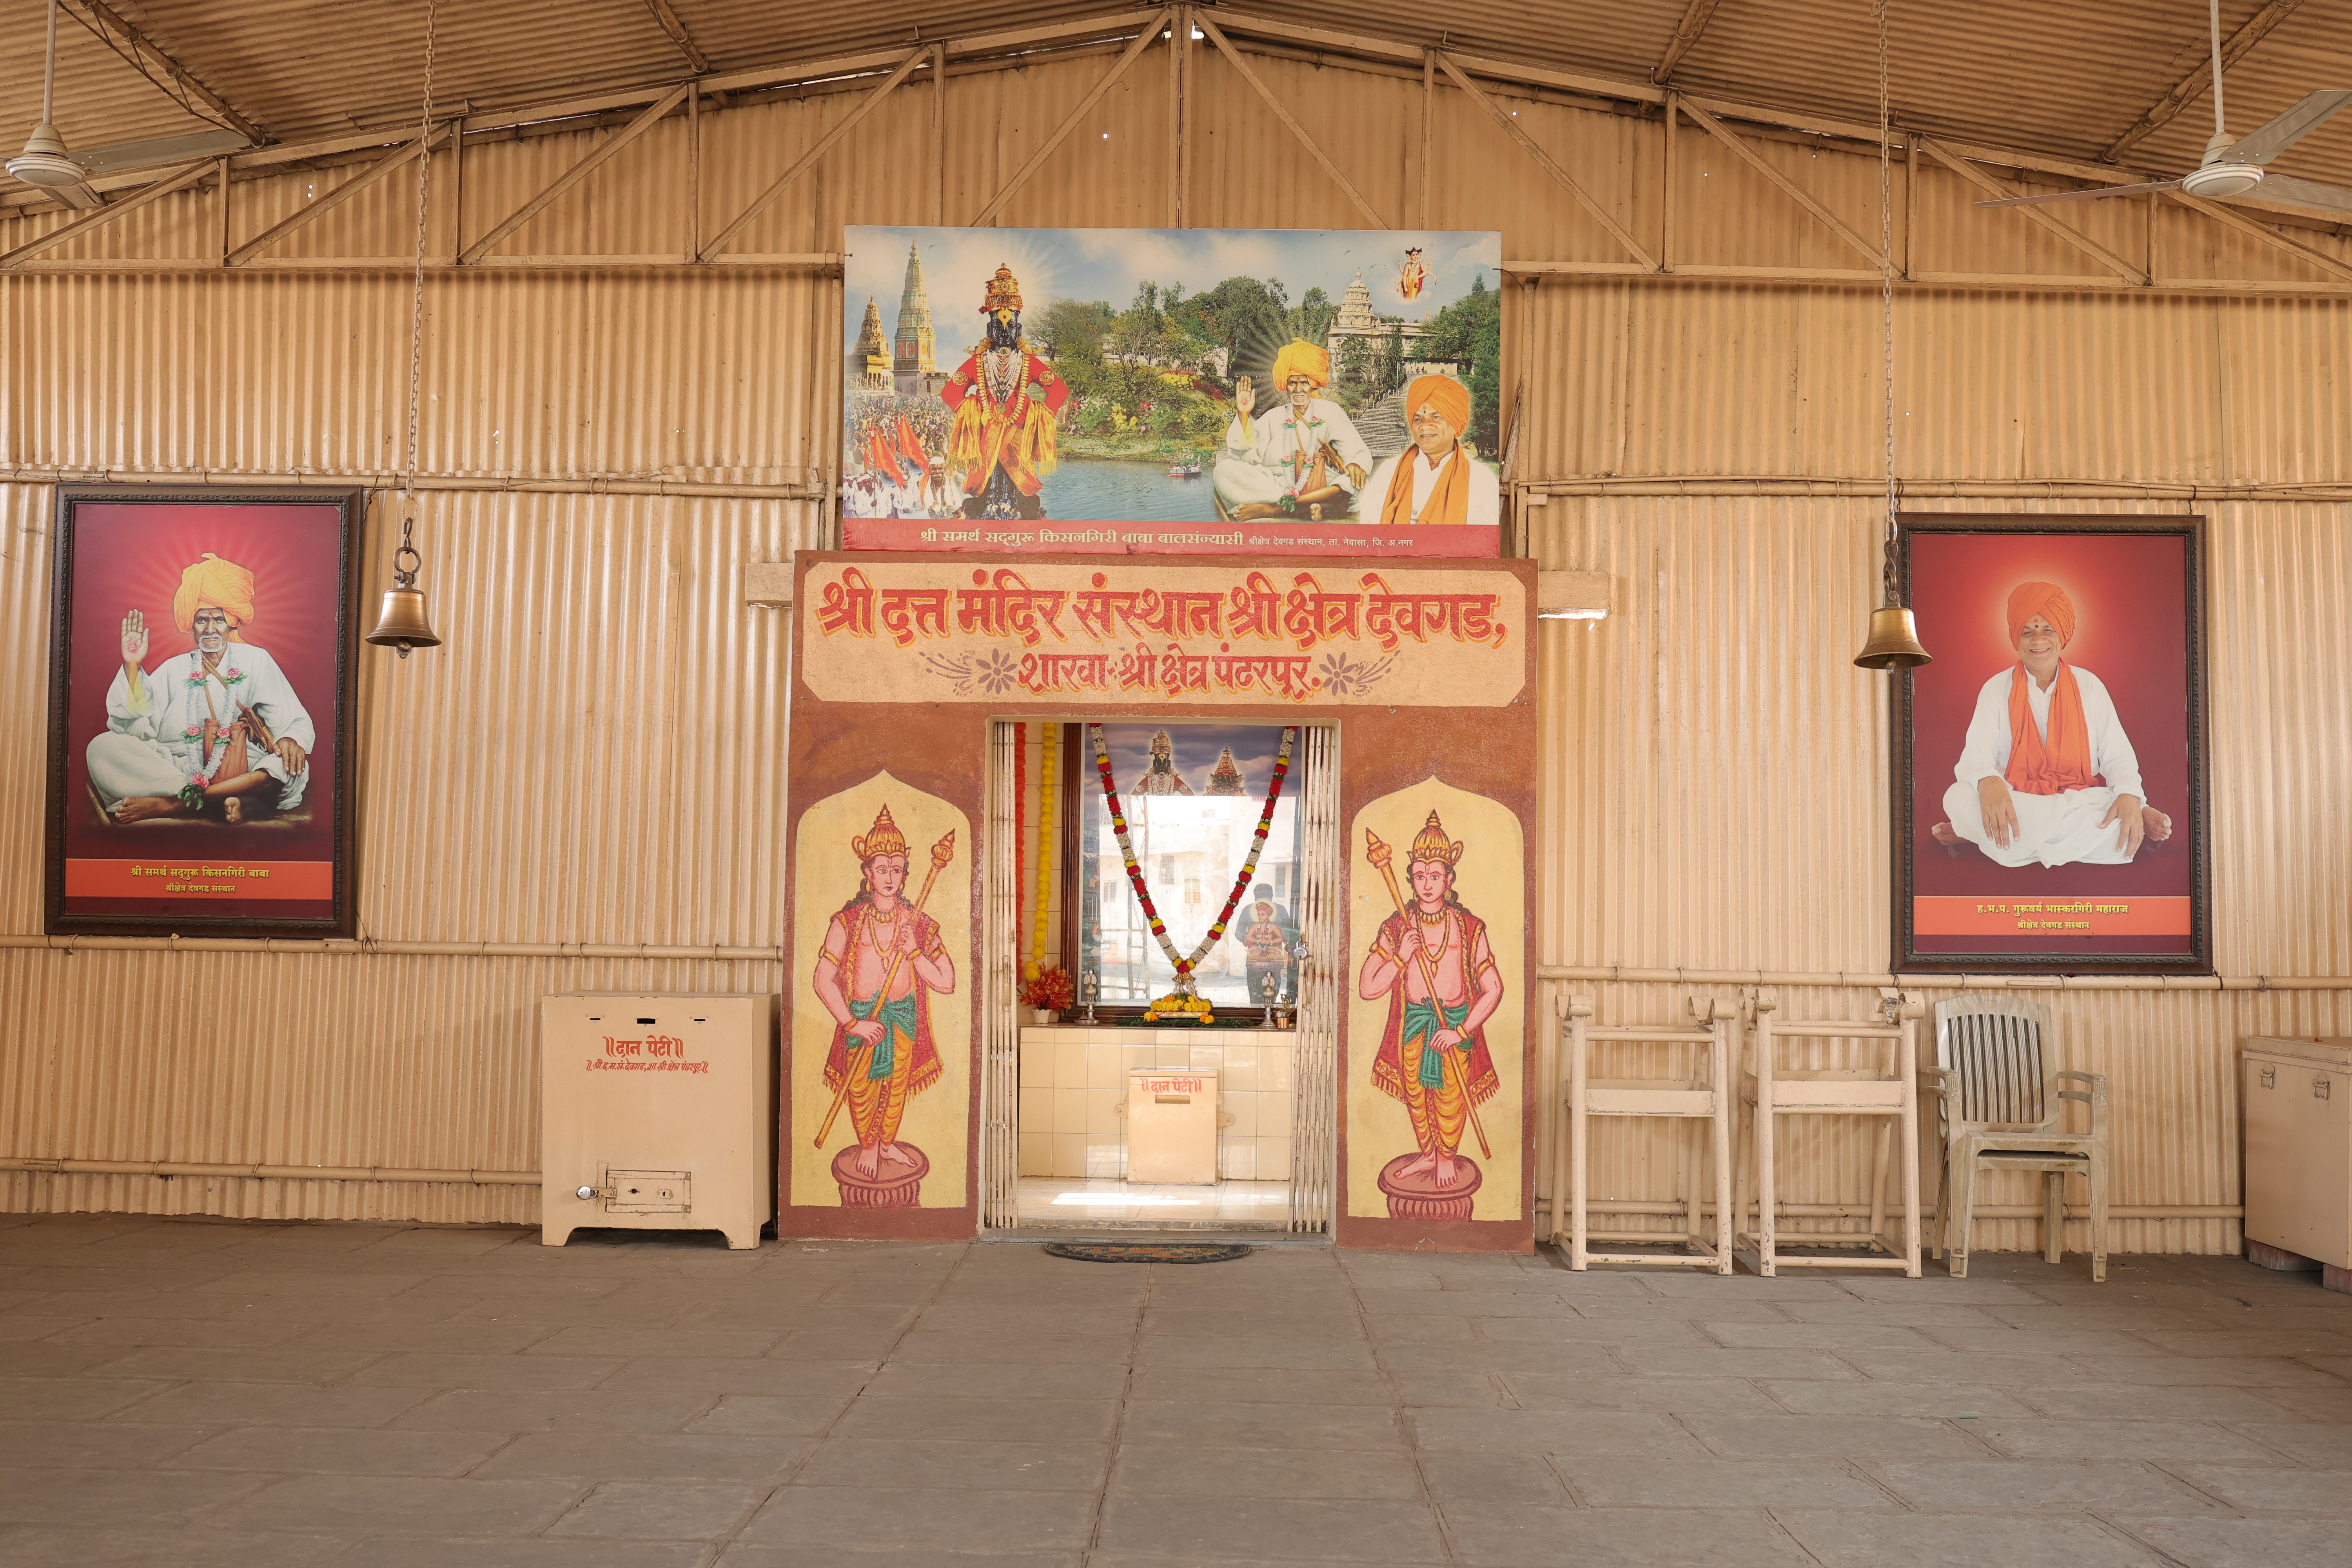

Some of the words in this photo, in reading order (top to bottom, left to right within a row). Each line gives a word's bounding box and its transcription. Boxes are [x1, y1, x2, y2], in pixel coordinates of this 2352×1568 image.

[921, 528, 937, 542] श्री
[942, 528, 980, 543] समर्थ
[985, 532, 1035, 546] सद्गुरू
[1039, 529, 1116, 543] किसनगिरी
[1122, 533, 1154, 544] बाबा
[1158, 531, 1244, 545] बालसंन्यासी
[1248, 535, 1270, 546] श्रीक्षेत्र
[1273, 535, 1294, 546] देवगड
[1297, 535, 1325, 547] संस्थान,
[1329, 538, 1340, 546] ता.
[1343, 535, 1368, 548] नेवासा,
[1372, 536, 1385, 547] जि.
[1388, 538, 1413, 548] अ.नगर
[818, 566, 876, 637] श्री
[881, 589, 950, 647] दत्त
[956, 568, 1068, 646] मंदिर
[1072, 572, 1225, 640] संस्थान
[1361, 572, 1507, 652] देवगड,
[1161, 643, 1209, 697] क्षेत्र
[131, 865, 142, 877] श्री
[144, 865, 168, 877] समर्थ
[169, 868, 199, 881] सद्गुरू
[201, 866, 246, 878] किसनगिरी
[248, 869, 270, 878] बाबा
[165, 882, 186, 893] श्रीक्षेत्र
[188, 882, 210, 893] देवगड
[211, 883, 236, 893] संस्थान
[1976, 904, 2010, 914] ह.भ.प.
[2013, 901, 2043, 917] गुरूवर्य
[2045, 901, 2093, 913] भास्करगिरी
[2095, 905, 2129, 915] महाराज
[2017, 919, 2038, 929] श्रीक्षेत्र
[2040, 919, 2063, 929] देवगड
[2064, 919, 2090, 929] संस्थान
